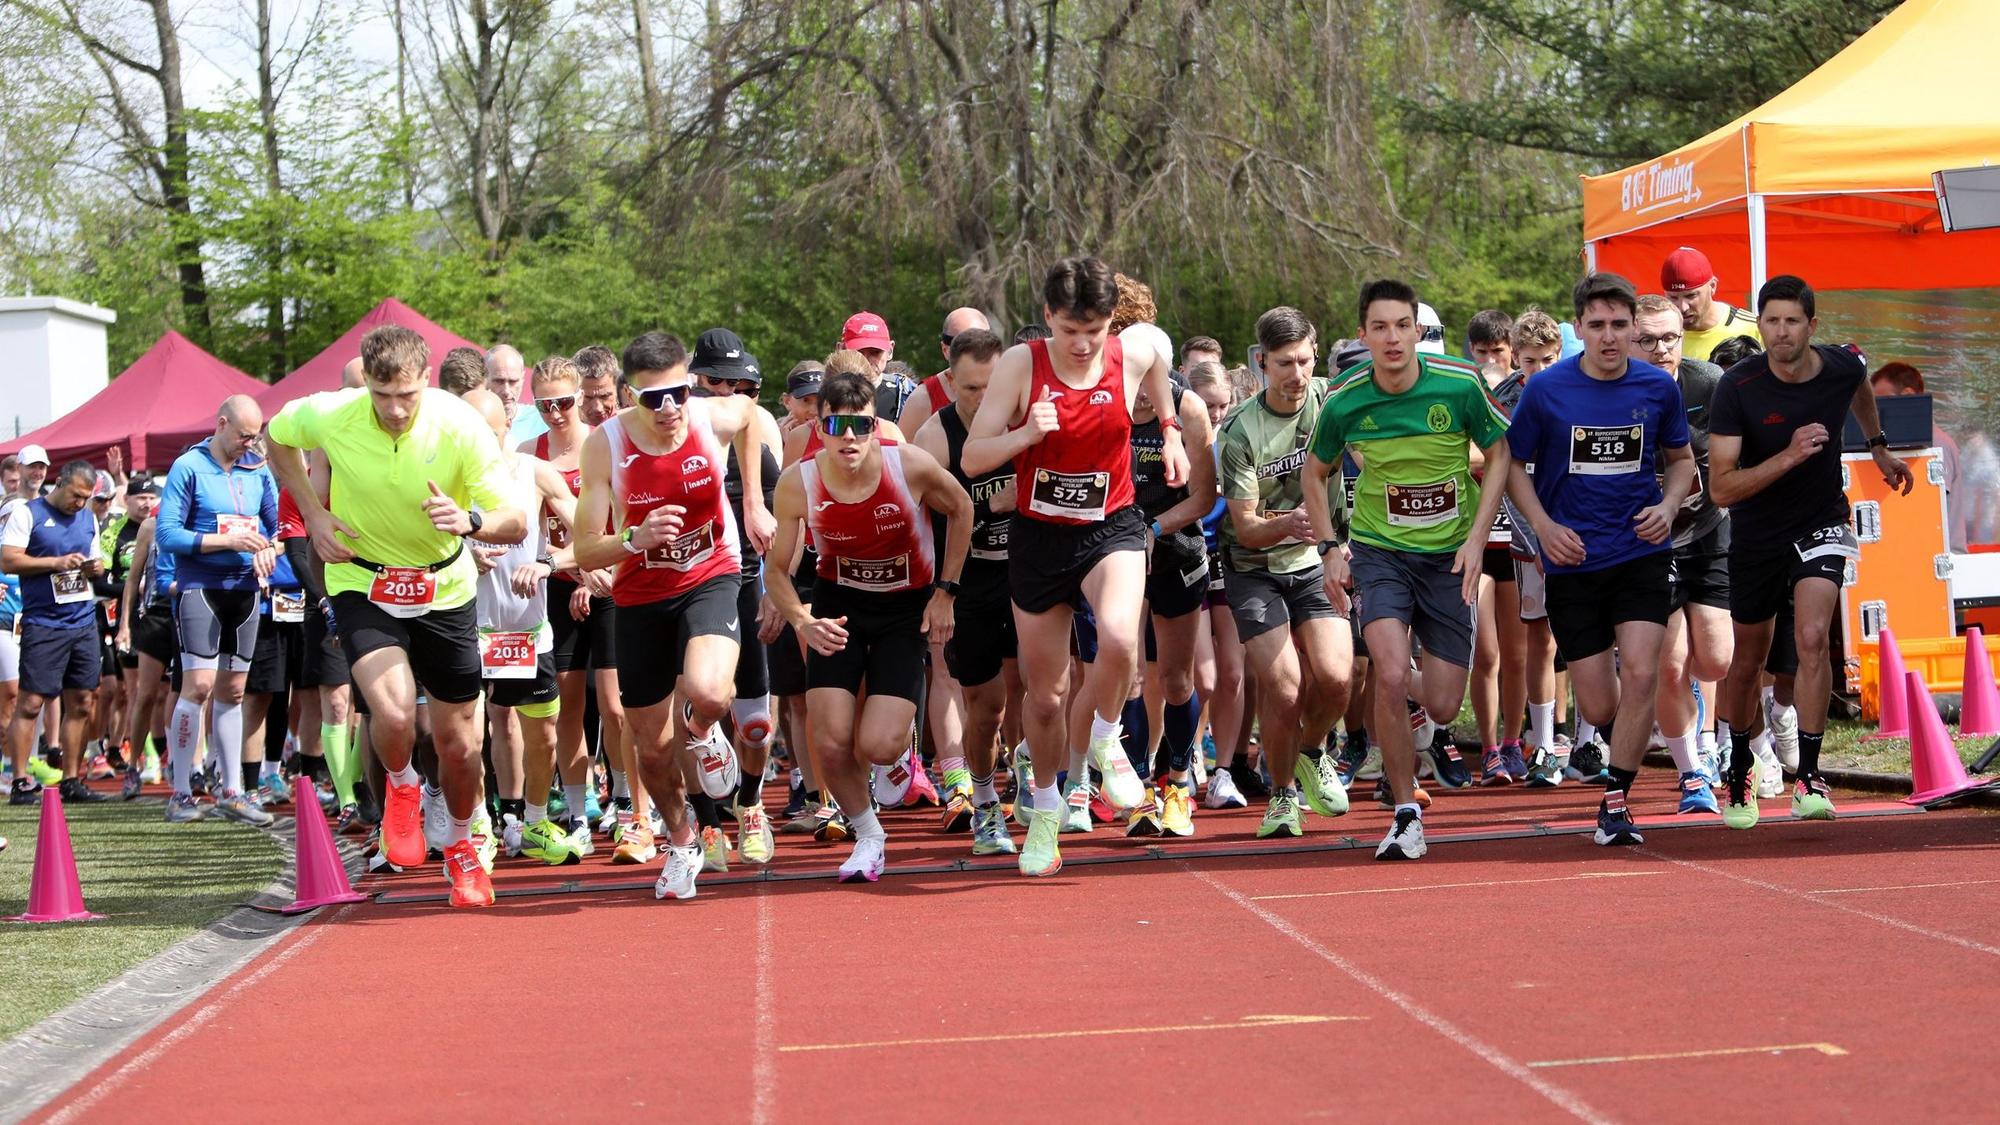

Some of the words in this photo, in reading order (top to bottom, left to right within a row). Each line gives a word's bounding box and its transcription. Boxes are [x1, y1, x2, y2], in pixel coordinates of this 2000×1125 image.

[1649, 158, 1694, 203] Timing
[1591, 442, 1625, 455] 518
[688, 476, 712, 488] inasys
[1053, 486, 1088, 501] 575
[1401, 496, 1445, 510] 1043
[874, 507, 891, 517] LAZ
[881, 521, 905, 531] inasys
[1494, 514, 1511, 525] 72
[988, 534, 1008, 545] 58
[1812, 526, 1843, 540] 529
[660, 539, 700, 559] 1070
[851, 569, 895, 579] 1071
[384, 581, 426, 596] 2015
[492, 646, 529, 659] 2018
